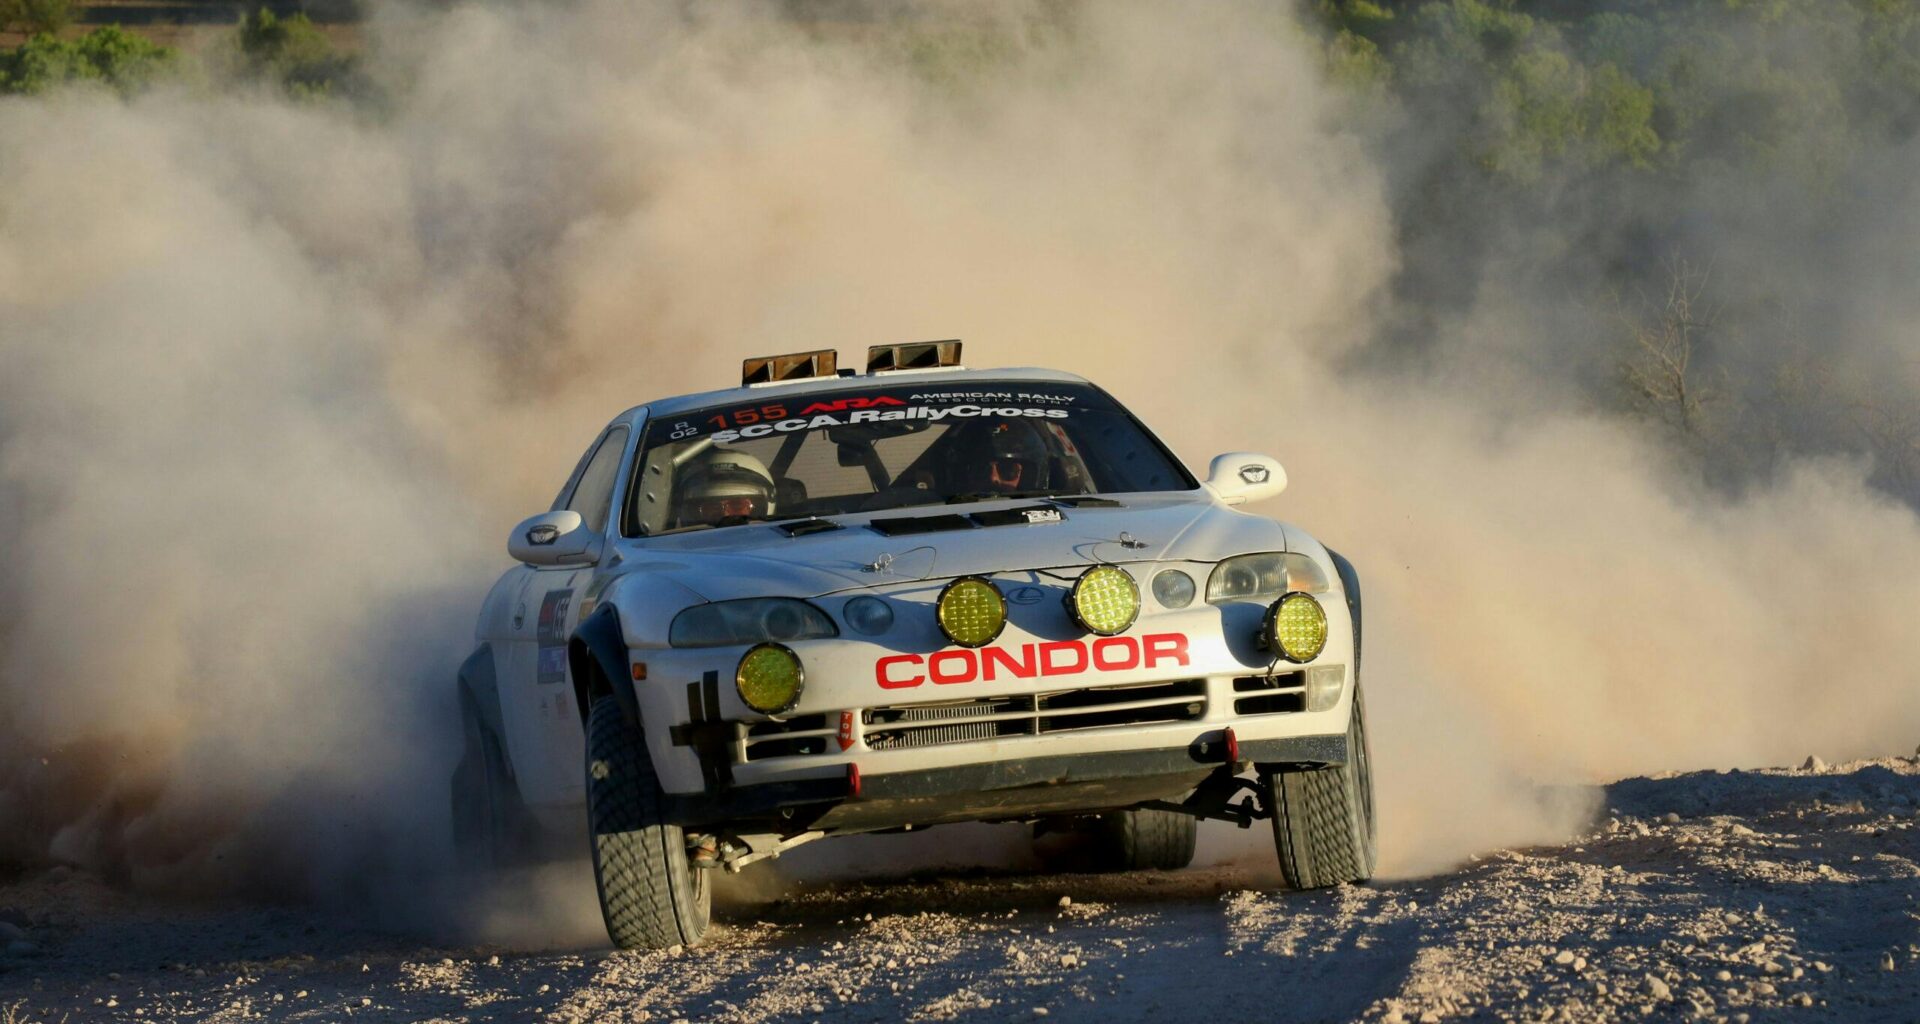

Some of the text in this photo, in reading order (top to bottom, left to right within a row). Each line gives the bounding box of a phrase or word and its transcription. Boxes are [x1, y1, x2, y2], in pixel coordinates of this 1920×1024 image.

[909, 392, 1076, 402] AMERICAN RALLY
[674, 421, 689, 430] R
[707, 396, 908, 429] 155 ARA
[710, 405, 1069, 443] SCCA.RallyCross
[875, 632, 1190, 690] CONDOR
[840, 712, 851, 739] TOW
